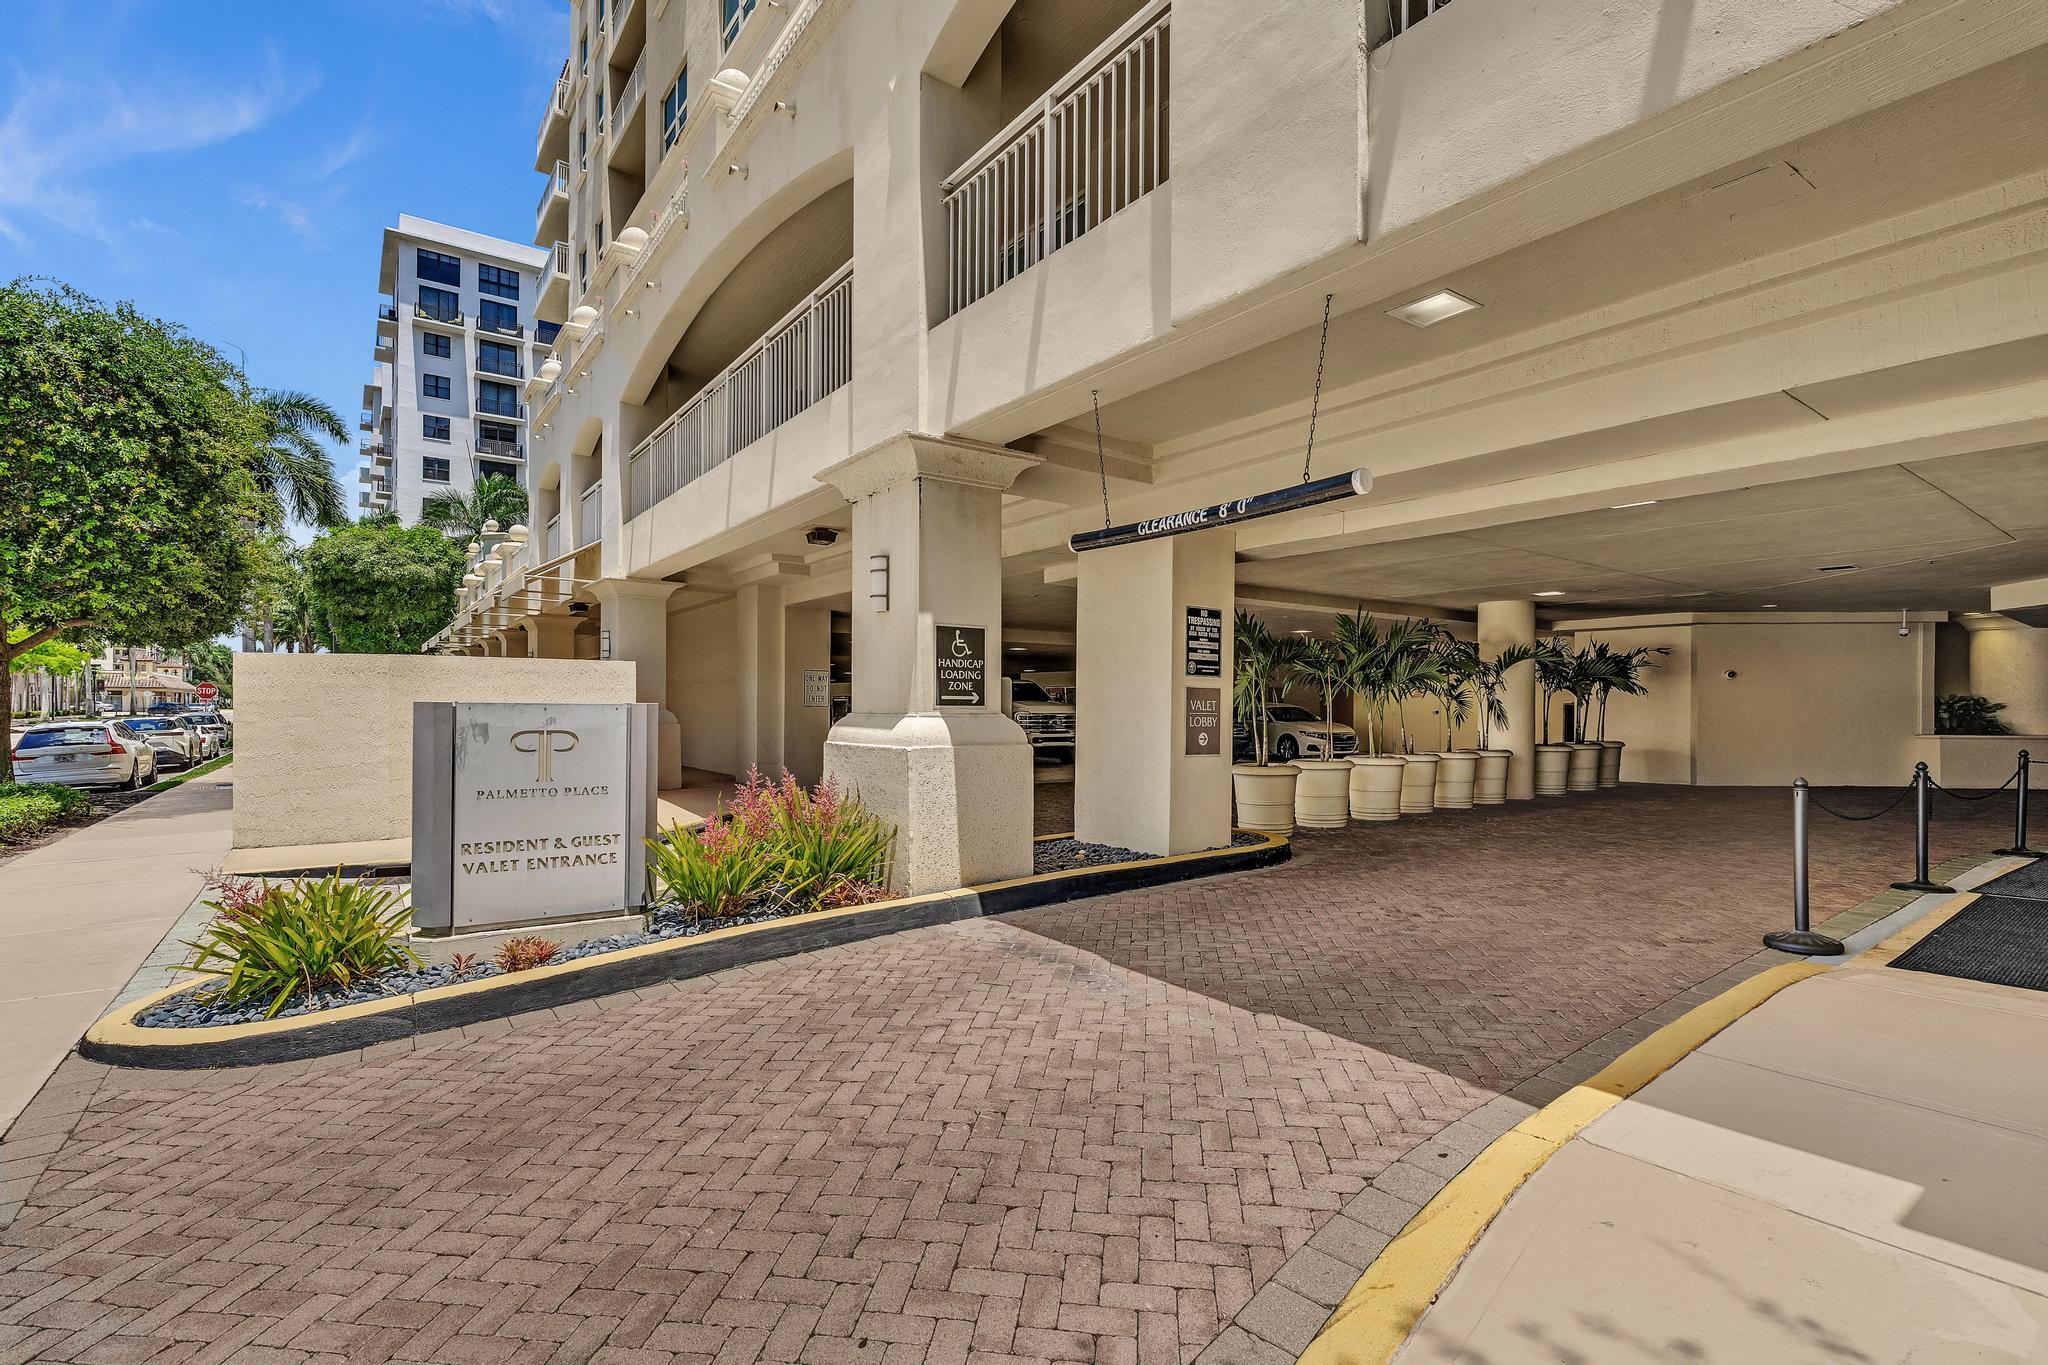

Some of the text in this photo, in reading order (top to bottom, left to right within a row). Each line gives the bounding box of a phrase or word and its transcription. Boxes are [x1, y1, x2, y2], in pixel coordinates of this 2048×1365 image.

[1138, 508, 1208, 535] CLEARANCE
[1200, 609, 1208, 617] NO
[1188, 616, 1220, 627] TRESPASSING
[938, 658, 984, 669] HANDICAP
[805, 674, 828, 683] ONE WAY
[940, 670, 981, 680] LOADING
[197, 687, 216, 695] STOP
[806, 684, 827, 693] DO NOT
[948, 681, 973, 691] ZONE
[808, 695, 825, 703] ENTER
[1190, 700, 1217, 711] VALET
[1189, 716, 1218, 727] LOBBY
[476, 785, 609, 800] PALMETTO PLACE
[460, 833, 621, 856] RESIDENT & GUEST
[462, 852, 618, 875] VALET ENTRANCE
